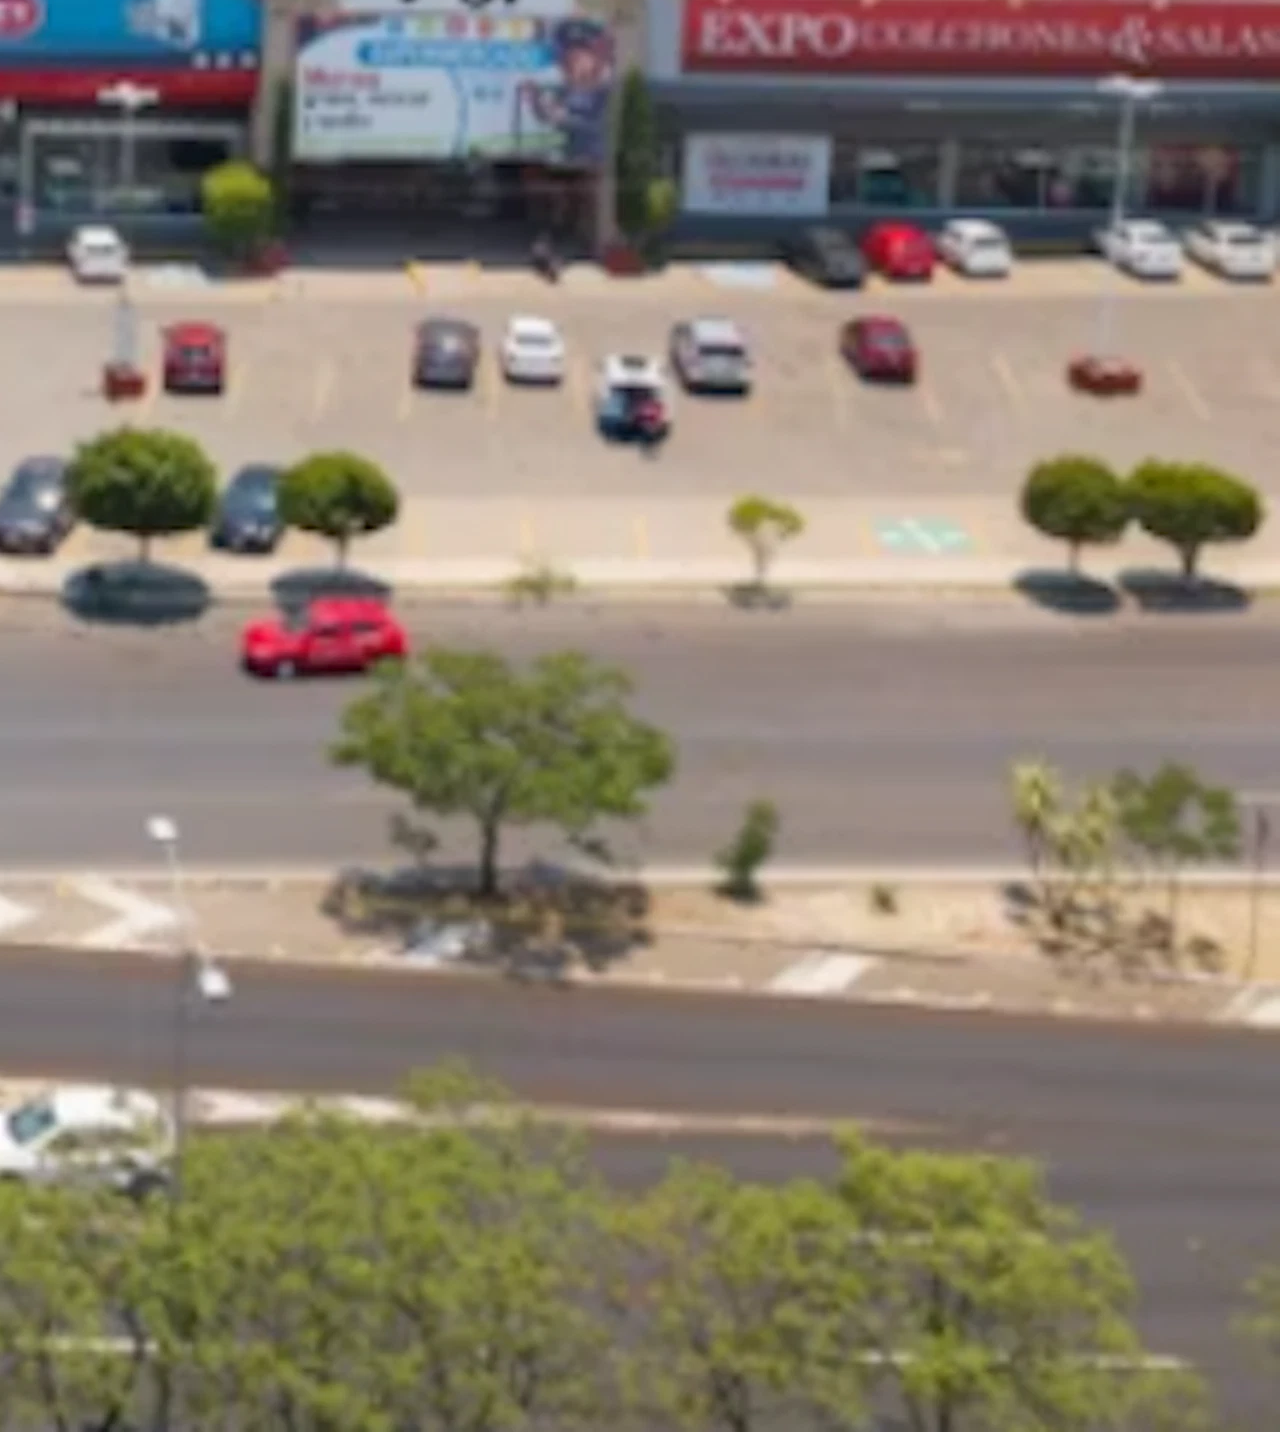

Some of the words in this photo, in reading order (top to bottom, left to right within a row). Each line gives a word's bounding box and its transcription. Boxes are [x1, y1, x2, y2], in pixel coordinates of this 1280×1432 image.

[701, 10, 857, 59] EXPO
[860, 19, 1104, 54] COLCHONES
[1108, 13, 1153, 70] &
